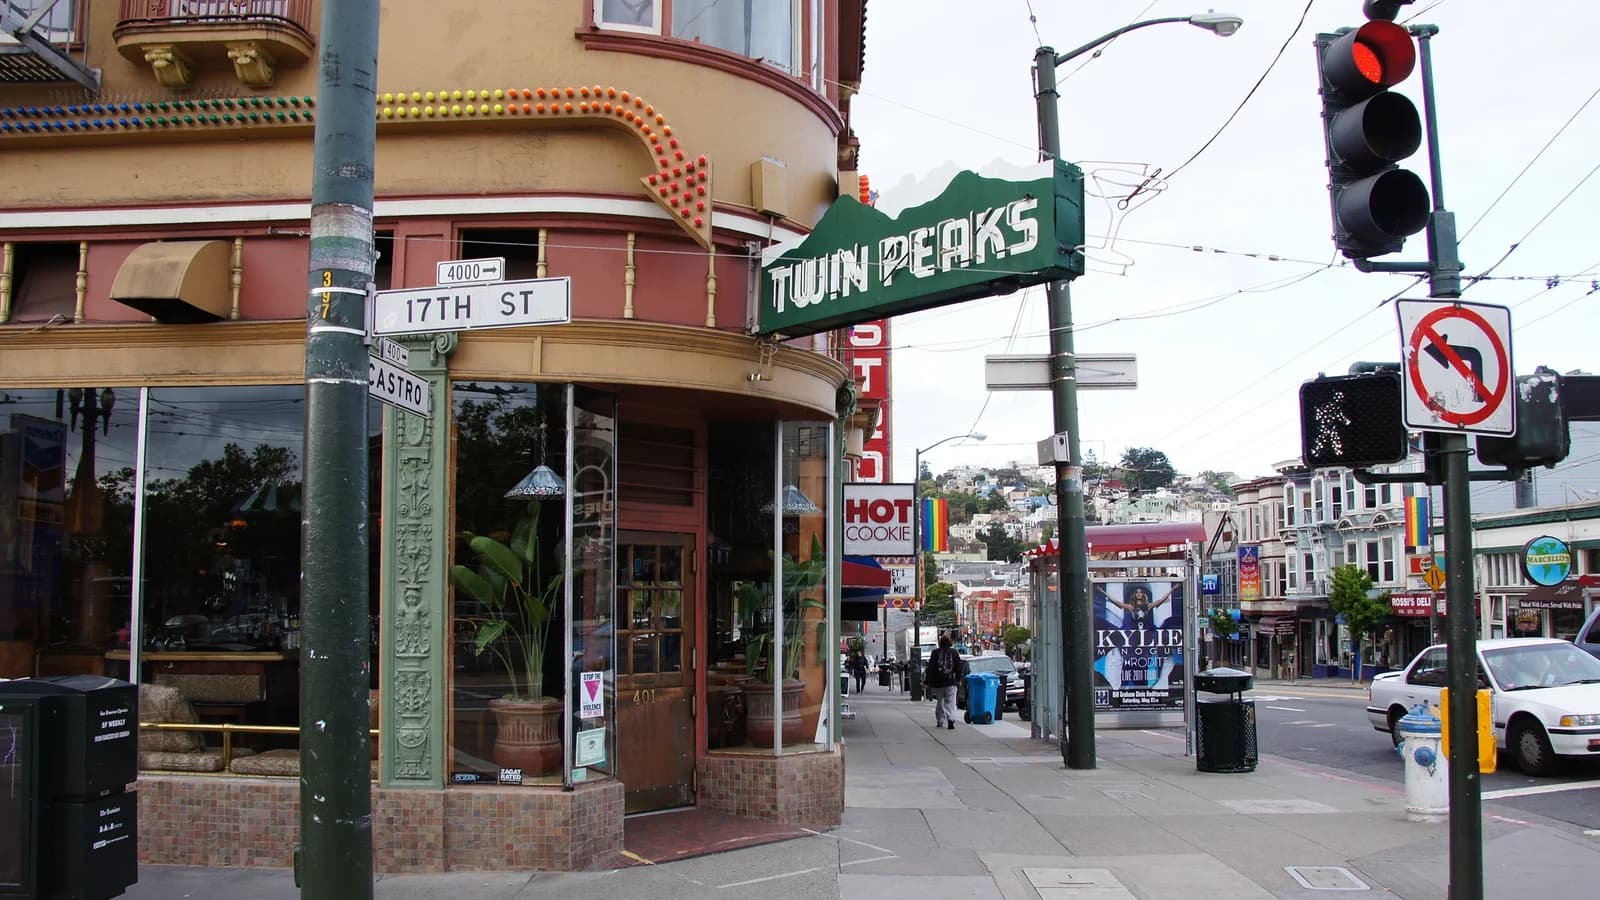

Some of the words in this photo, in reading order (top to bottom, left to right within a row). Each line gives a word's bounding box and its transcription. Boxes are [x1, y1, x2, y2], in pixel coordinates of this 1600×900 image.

[768, 244, 869, 313] TWIN
[879, 198, 1038, 287] PEAKS
[447, 263, 480, 280] 4000
[406, 294, 471, 323] 17TH
[501, 290, 533, 316] ST
[387, 343, 400, 360] 400
[368, 363, 421, 405] CASTRO
[846, 499, 912, 523] HOT
[846, 526, 911, 541] COOKIE
[1527, 554, 1570, 563] MARCELLO'S
[1391, 597, 1415, 606] ROSSI'S
[1416, 597, 1431, 606] DELI
[1096, 629, 1183, 647] KYLIE
[1097, 647, 1183, 655] MINOGUE
[633, 689, 655, 705] 401
